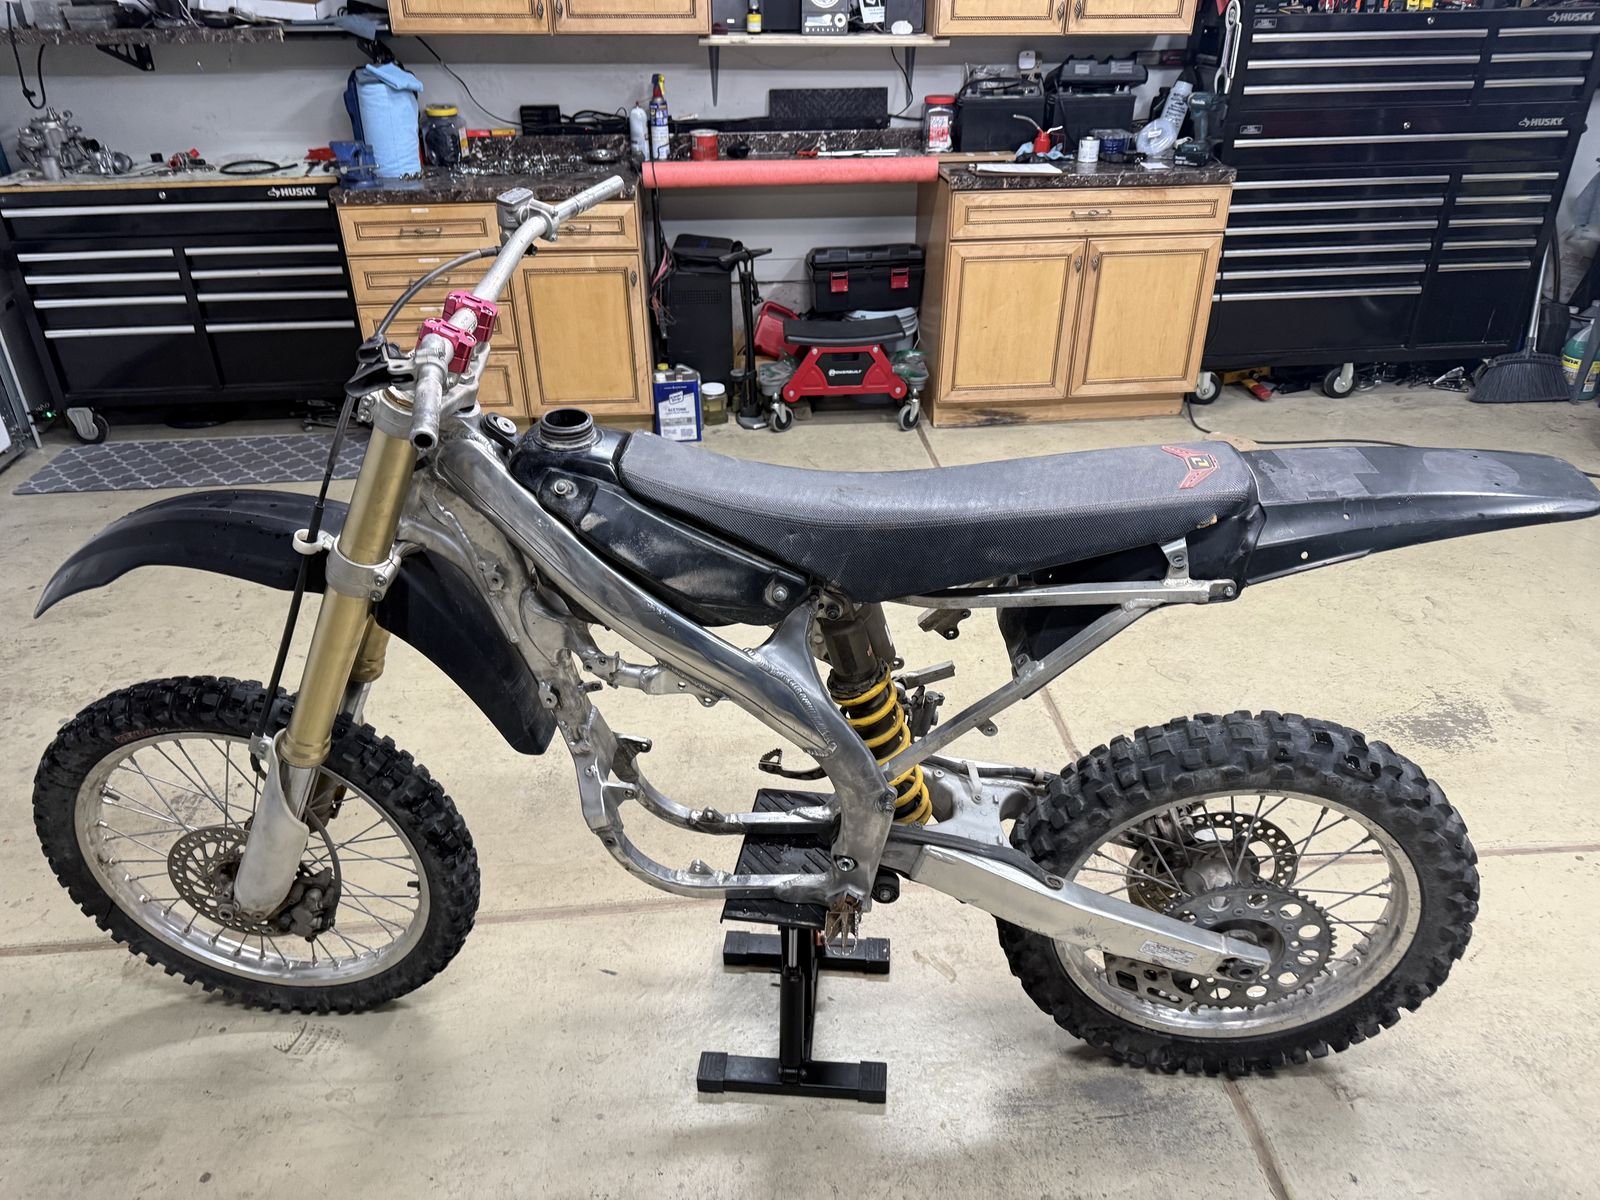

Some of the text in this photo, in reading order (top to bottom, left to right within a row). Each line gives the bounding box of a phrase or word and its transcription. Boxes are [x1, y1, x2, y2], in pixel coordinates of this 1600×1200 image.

[1560, 11, 1595, 21] HUSKY
[1530, 117, 1564, 126] HUSKY
[280, 186, 318, 197] HUSKY
